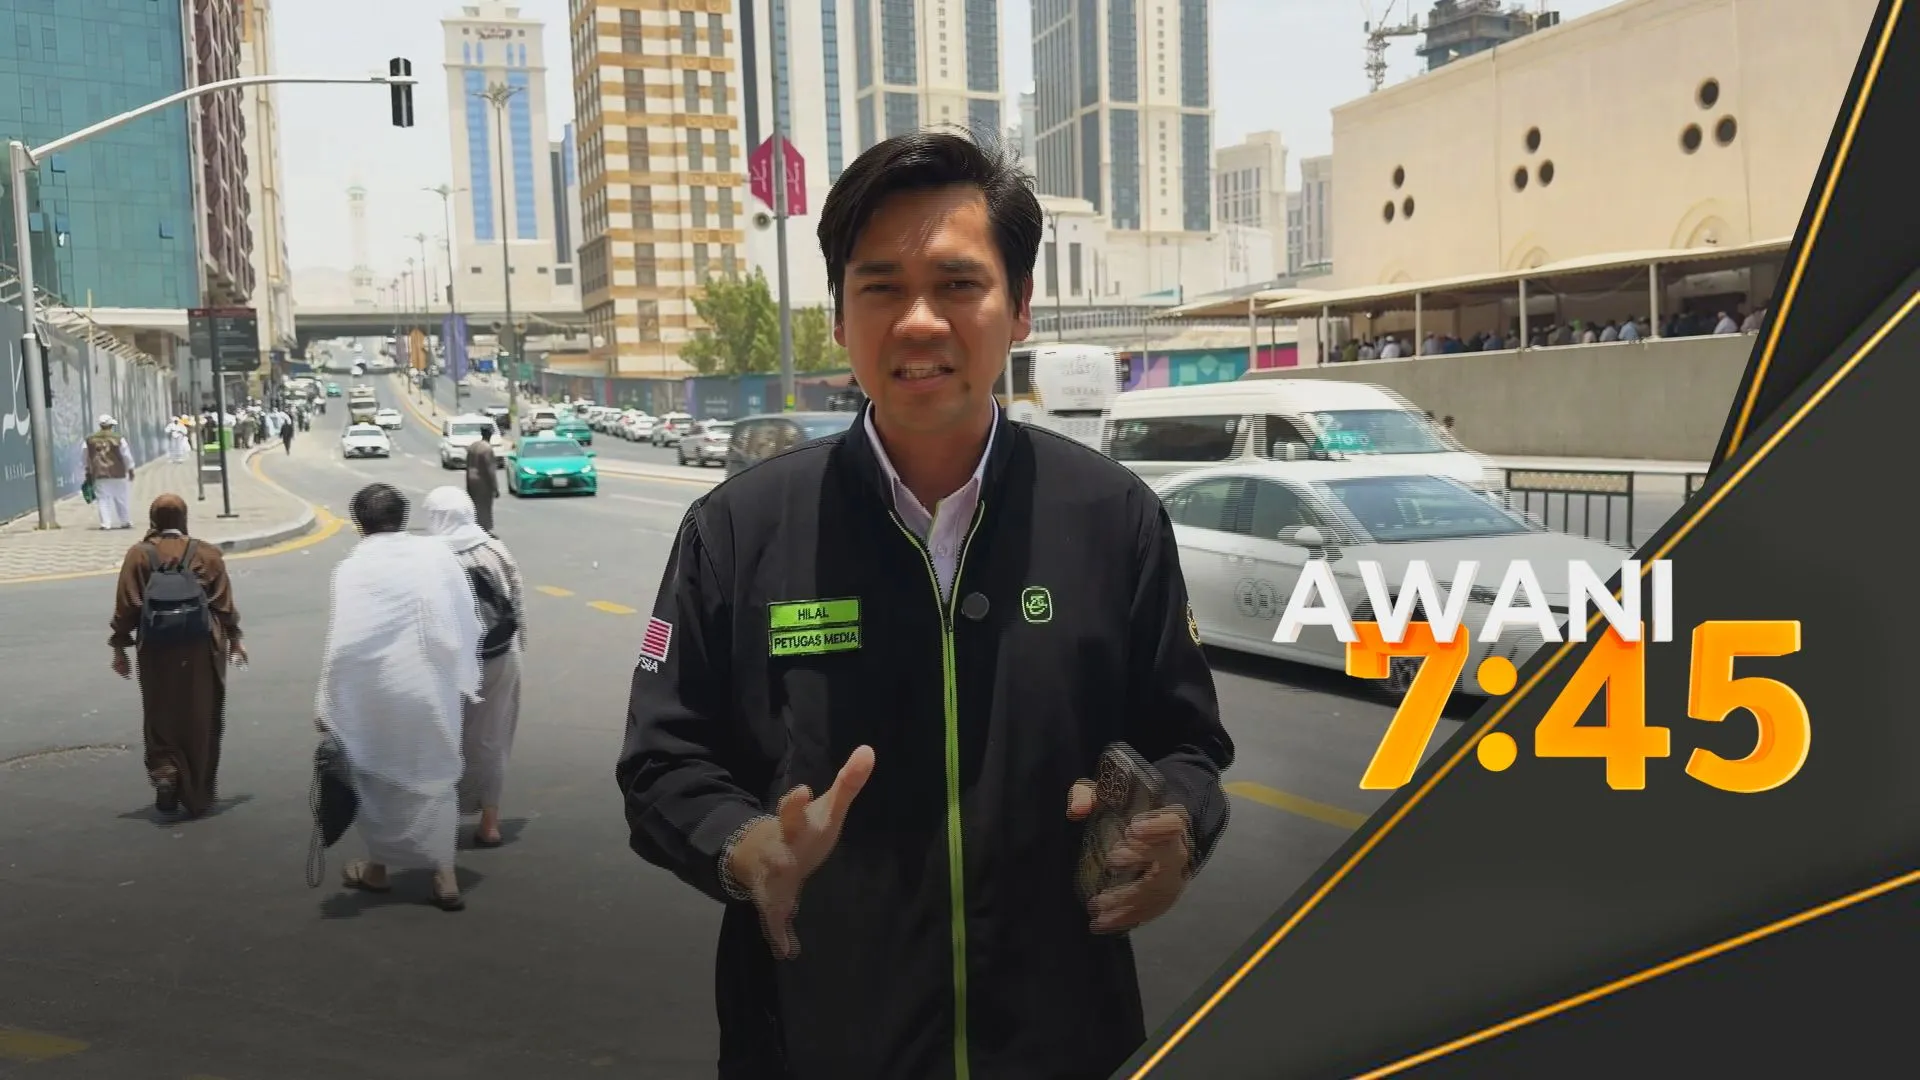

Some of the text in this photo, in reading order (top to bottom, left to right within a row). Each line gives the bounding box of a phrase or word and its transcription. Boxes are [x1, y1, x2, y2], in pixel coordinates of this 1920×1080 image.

[797, 607, 829, 620] HILAL
[774, 631, 858, 649] PETUGAS MEDIA
